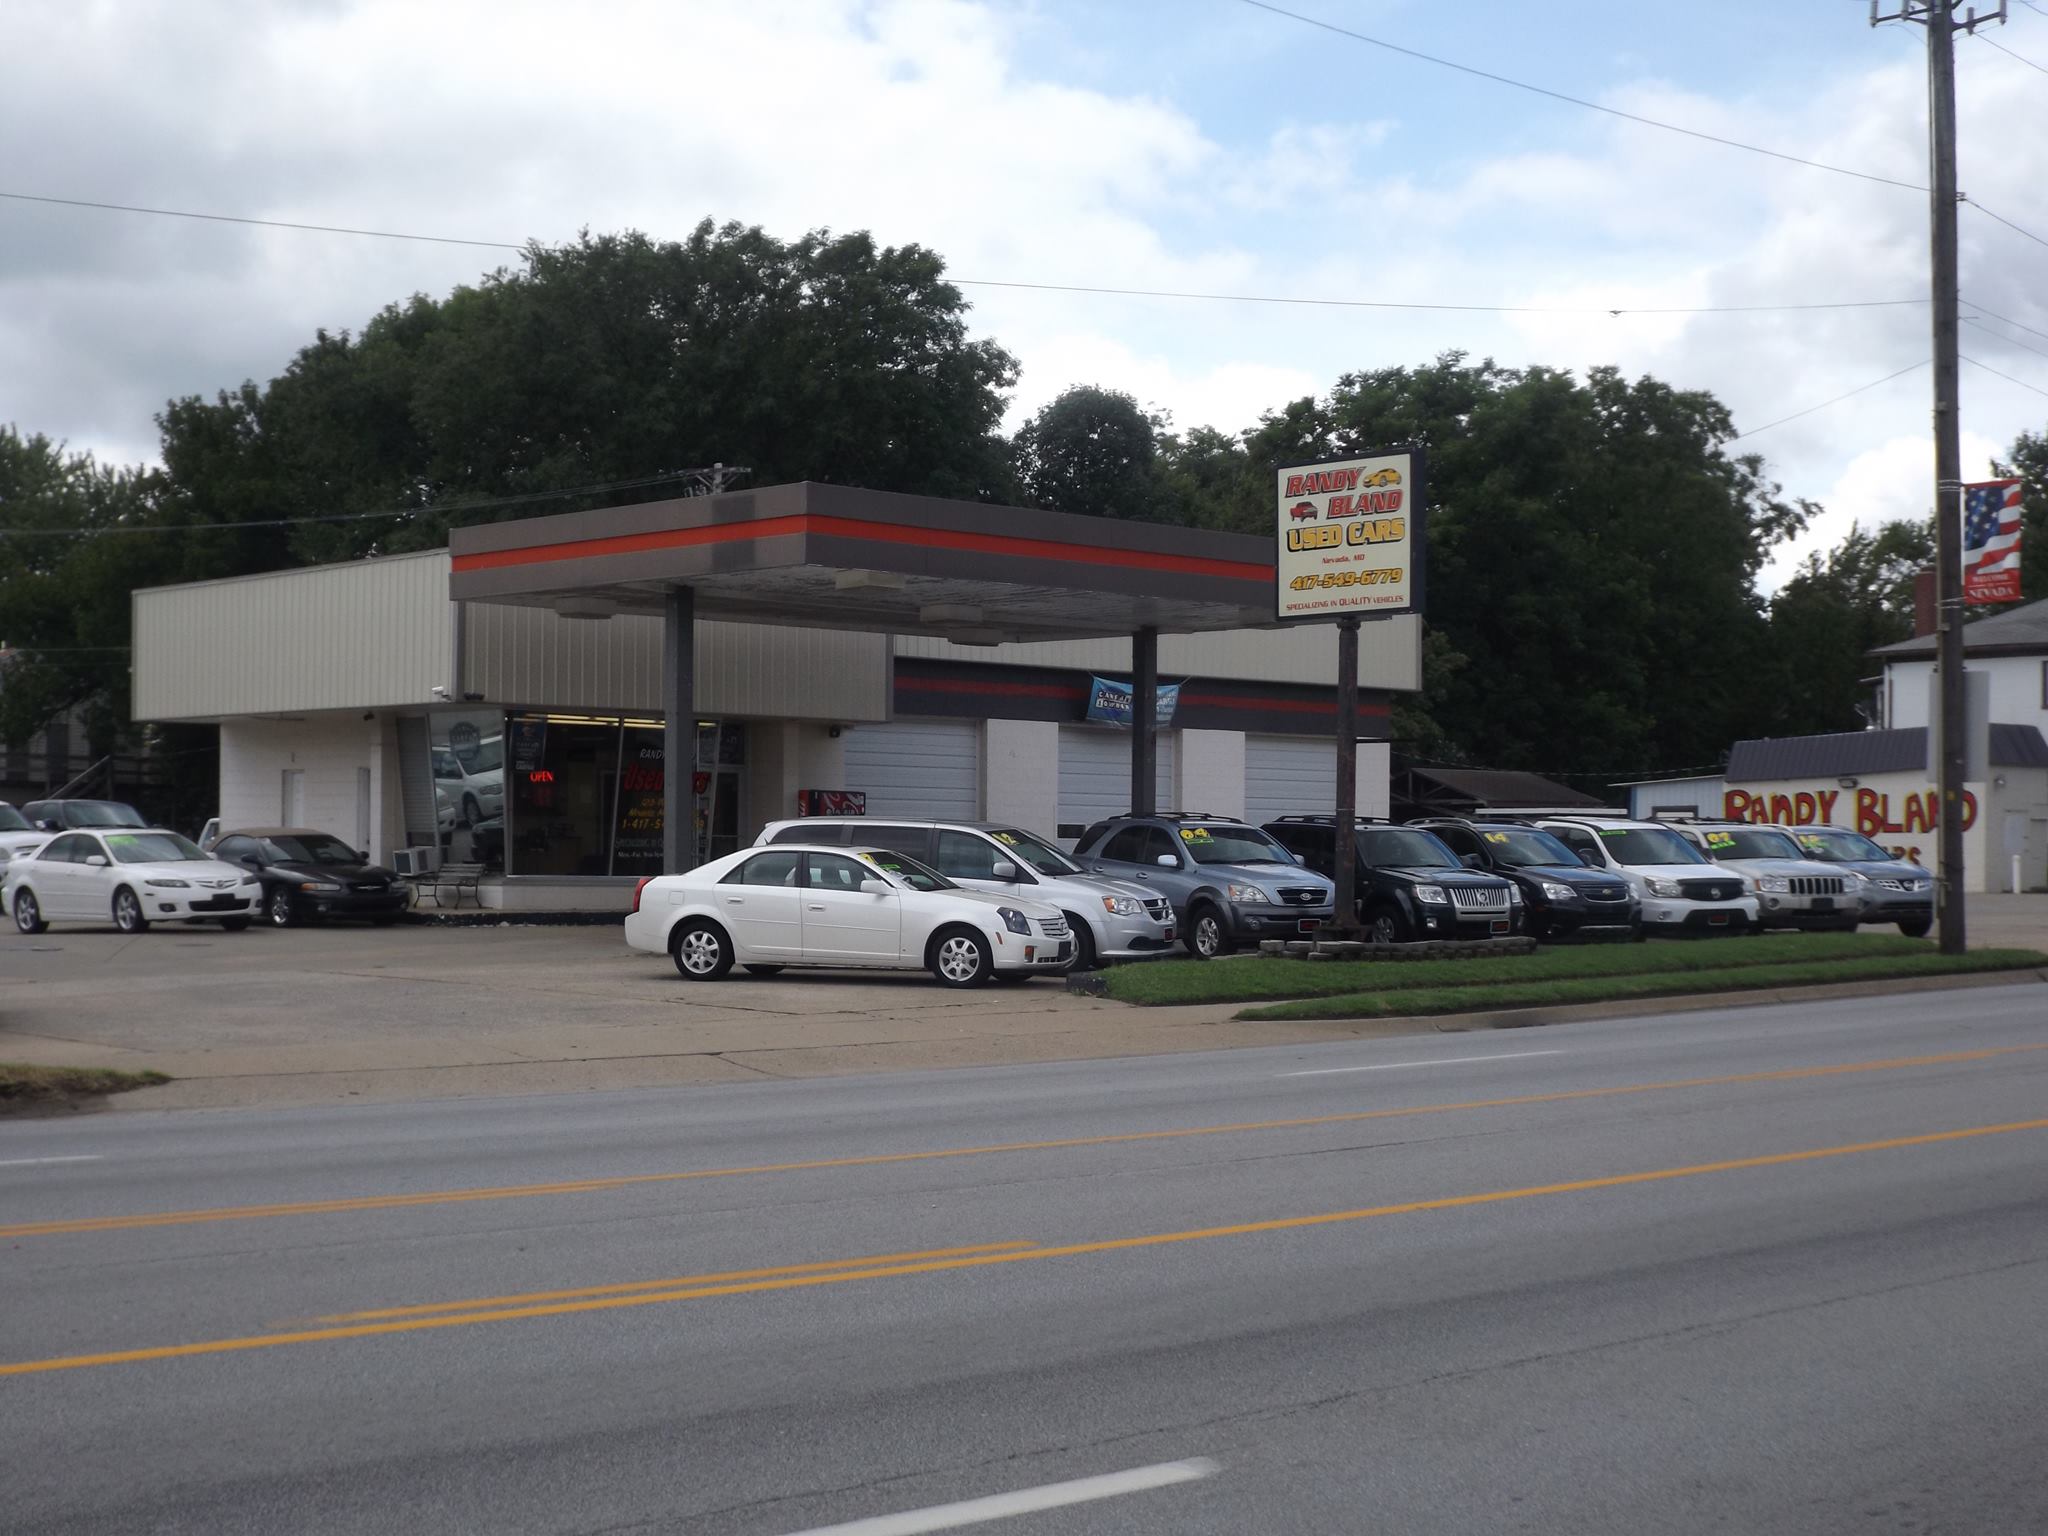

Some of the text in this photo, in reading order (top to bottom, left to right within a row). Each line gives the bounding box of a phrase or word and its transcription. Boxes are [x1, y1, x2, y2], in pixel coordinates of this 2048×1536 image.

[1285, 466, 1367, 498] RANDY
[1327, 489, 1404, 520] BLAND
[1287, 517, 1405, 552] USED CARS
[1290, 568, 1403, 590] 417-549-6779
[1286, 595, 1404, 611] SPECIALIZING IN QUALITY VEHICLES
[529, 770, 554, 784] OPEN
[1723, 787, 1978, 838] RANDY BLAND
